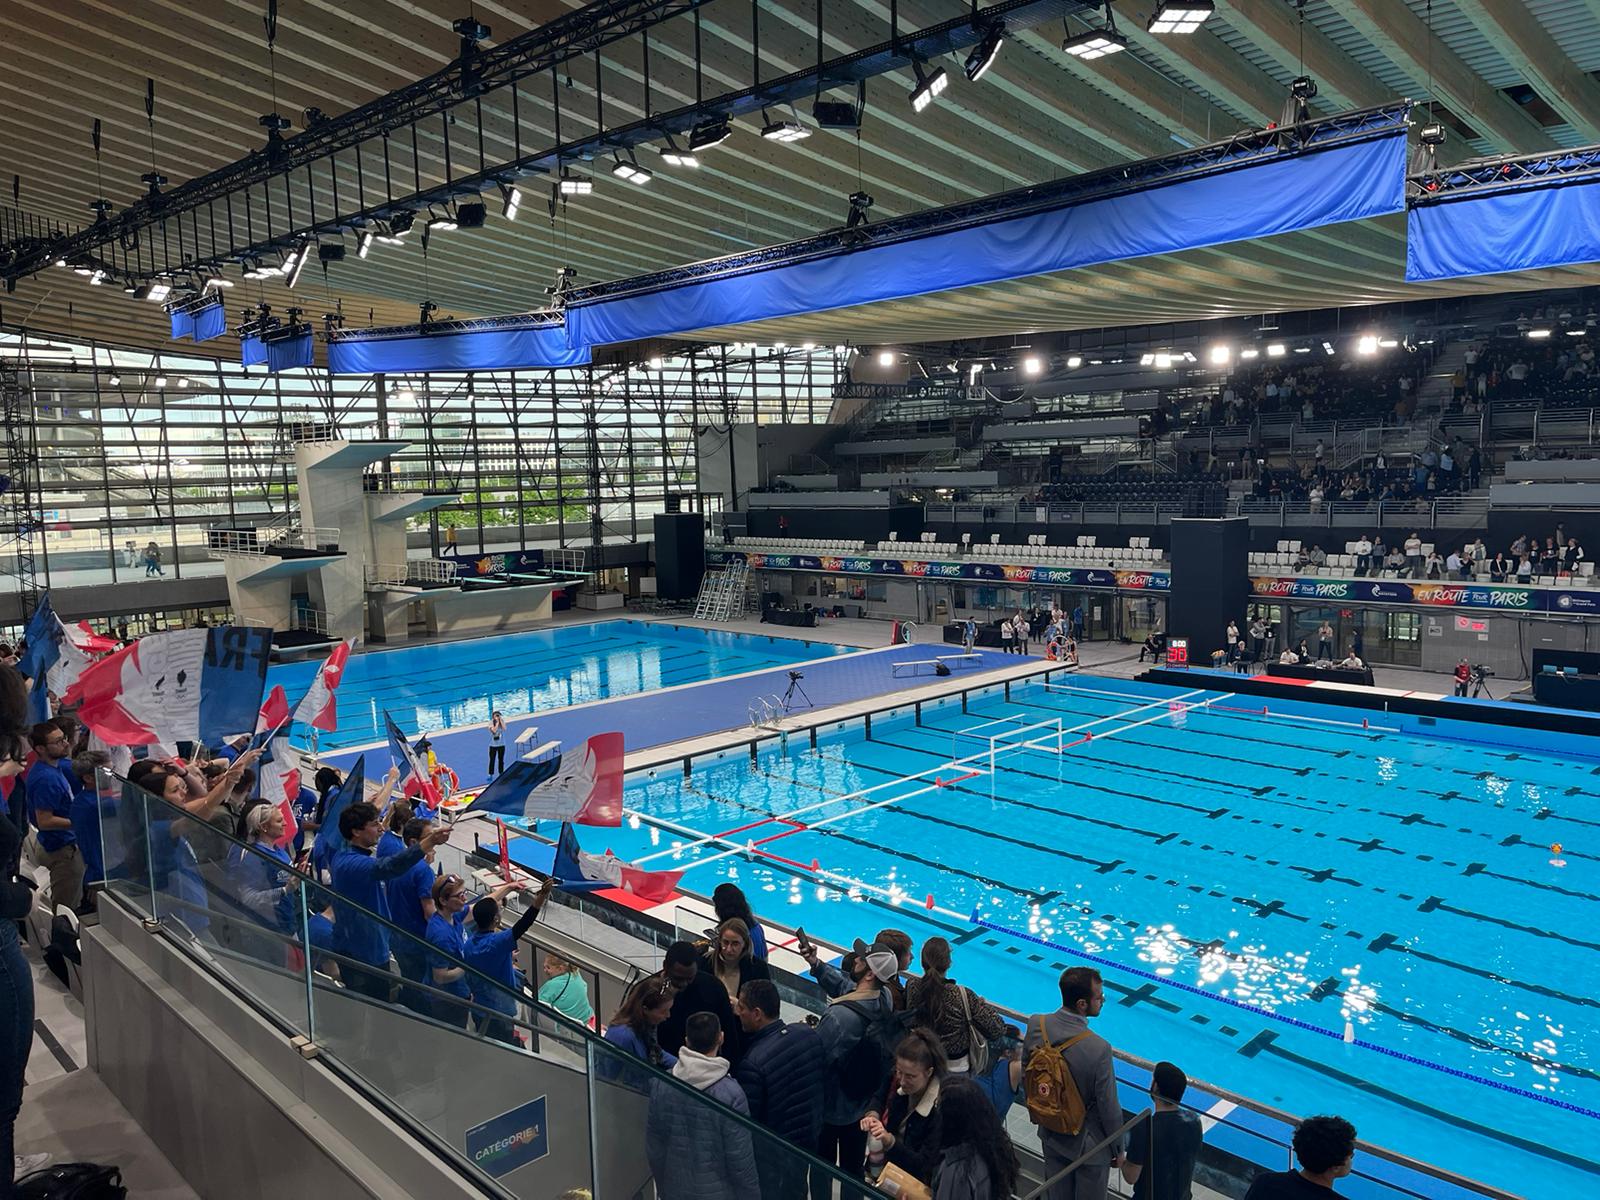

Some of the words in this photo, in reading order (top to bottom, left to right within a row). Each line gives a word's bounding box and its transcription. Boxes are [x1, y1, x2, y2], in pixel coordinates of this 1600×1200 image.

[940, 565, 961, 576] PARIS
[1015, 569, 1037, 580] ROUTE
[1048, 570, 1071, 582] PARIS
[1128, 574, 1154, 587] ROUTE
[1257, 582, 1268, 593] EN
[1270, 580, 1300, 594] ROUTE
[1315, 583, 1348, 597] PARIS
[1418, 590, 1430, 601] EN
[1433, 588, 1470, 603] ROUTE
[1490, 590, 1529, 607] PARIS
[475, 1127, 534, 1161] CATÉGORIE
